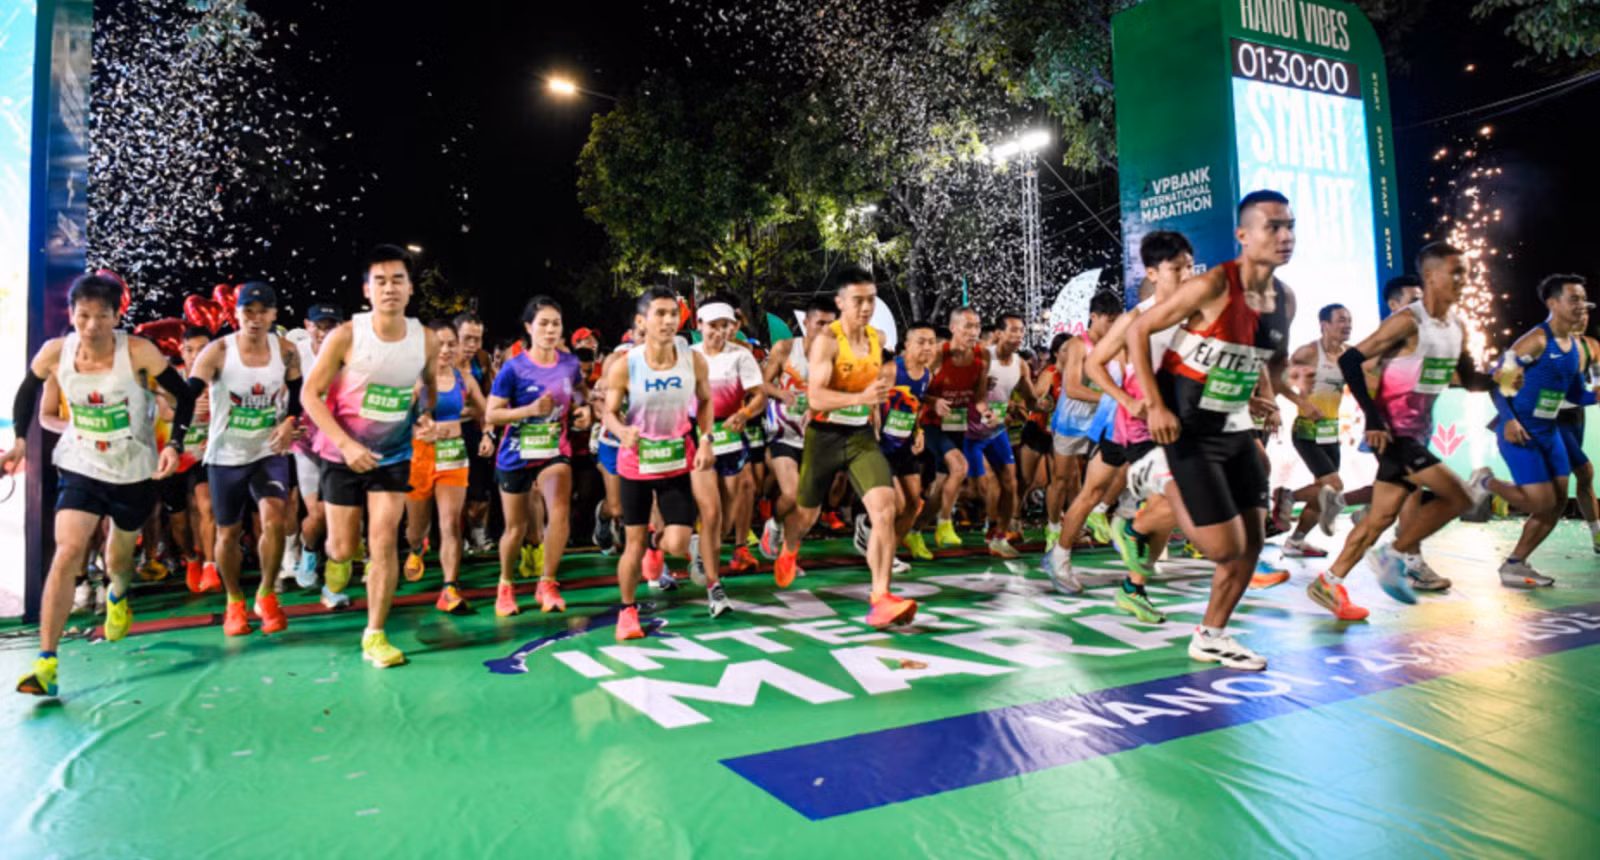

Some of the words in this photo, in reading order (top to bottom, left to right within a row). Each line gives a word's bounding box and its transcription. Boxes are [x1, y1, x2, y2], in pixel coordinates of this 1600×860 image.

[1240, 0, 1298, 40] HANOI
[1299, 0, 1350, 52] VIBES
[1238, 43, 1349, 94] 01:30:00
[1246, 81, 1348, 172] START
[1141, 184, 1211, 208] INTERNATIONAL
[1152, 166, 1210, 195] VPBANK
[1380, 176, 1389, 216] START
[1141, 194, 1212, 224] MARATHON
[1384, 228, 1393, 268] START
[645, 376, 682, 392] HYR
